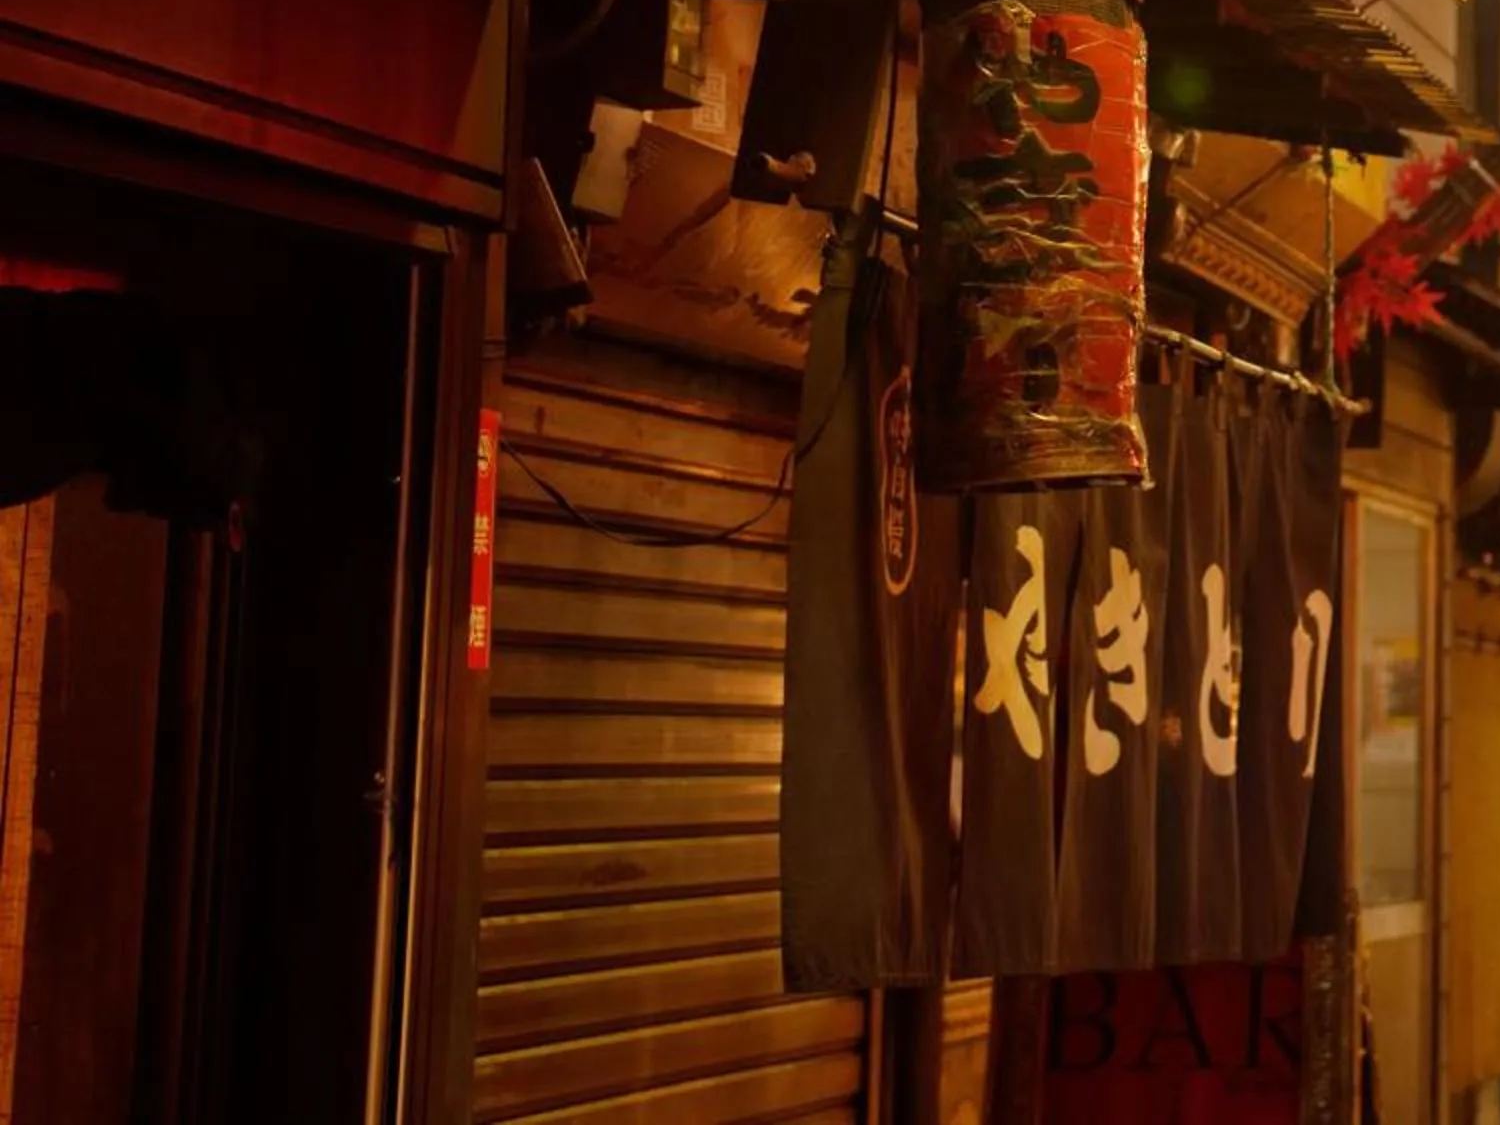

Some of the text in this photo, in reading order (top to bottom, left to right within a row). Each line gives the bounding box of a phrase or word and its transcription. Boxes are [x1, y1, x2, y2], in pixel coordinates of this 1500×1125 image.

[975, 525, 1333, 777] やきとり
[1048, 967, 1302, 1070] BAR
